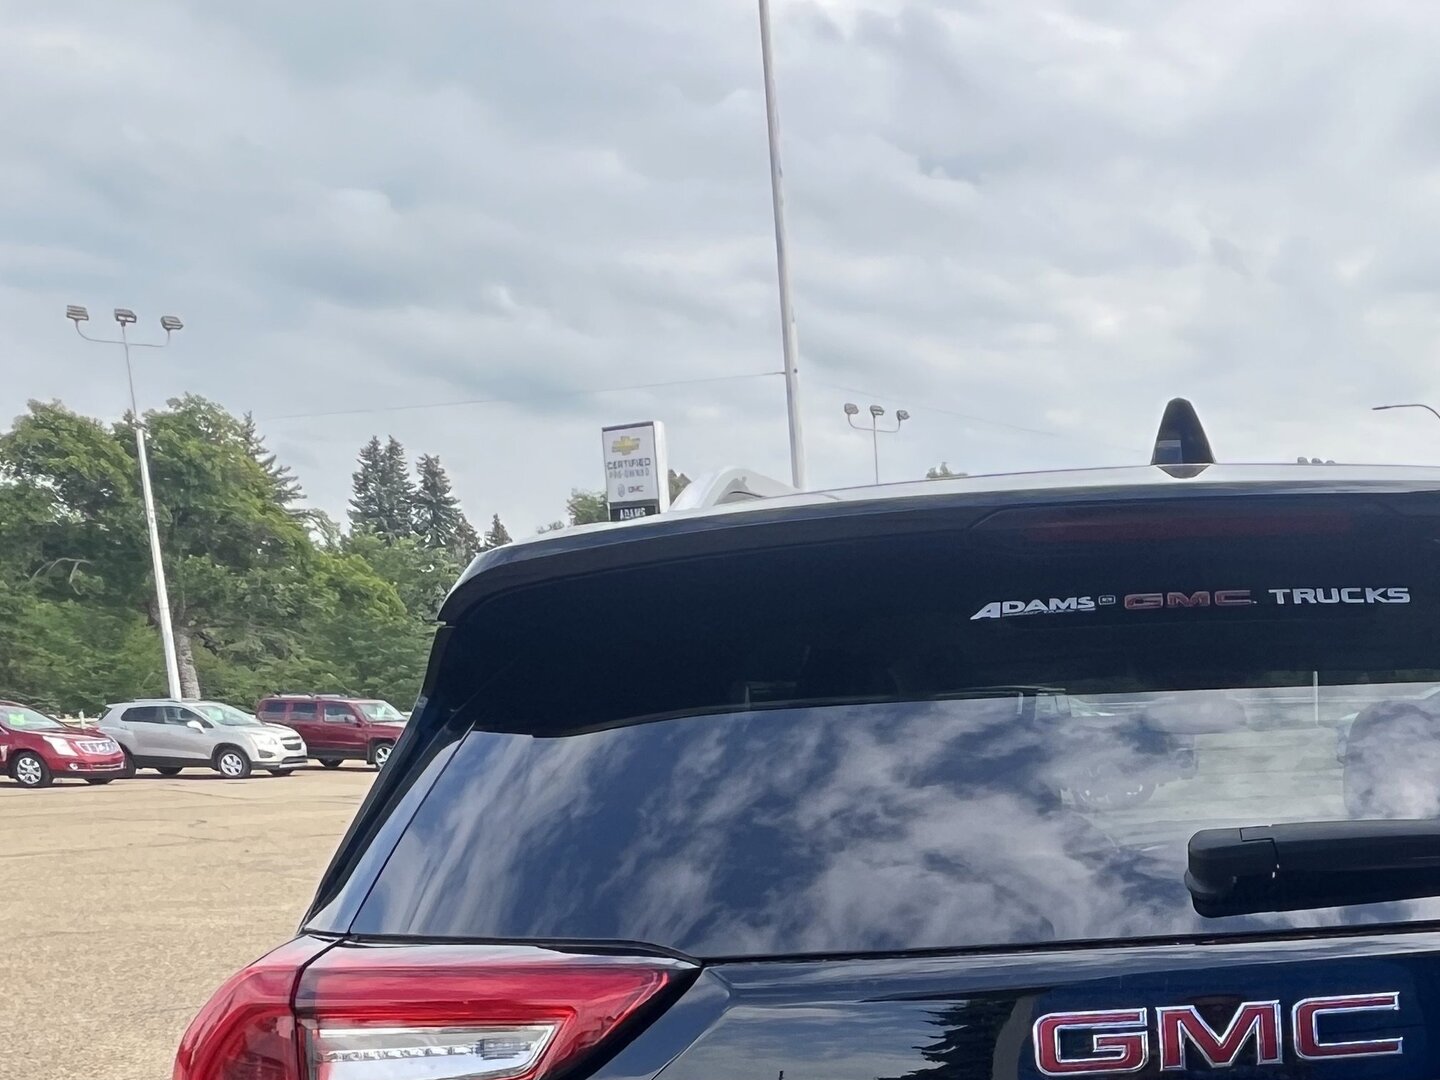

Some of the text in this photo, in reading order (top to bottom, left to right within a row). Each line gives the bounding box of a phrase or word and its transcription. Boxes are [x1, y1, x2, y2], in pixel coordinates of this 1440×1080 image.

[607, 457, 651, 470] CERTIFIED
[620, 507, 646, 520] ADAMS
[969, 597, 1095, 620] ADAMS
[1124, 589, 1251, 609] GMC
[1268, 587, 1411, 604] TRUCKS
[1032, 991, 1404, 1077] GMC
